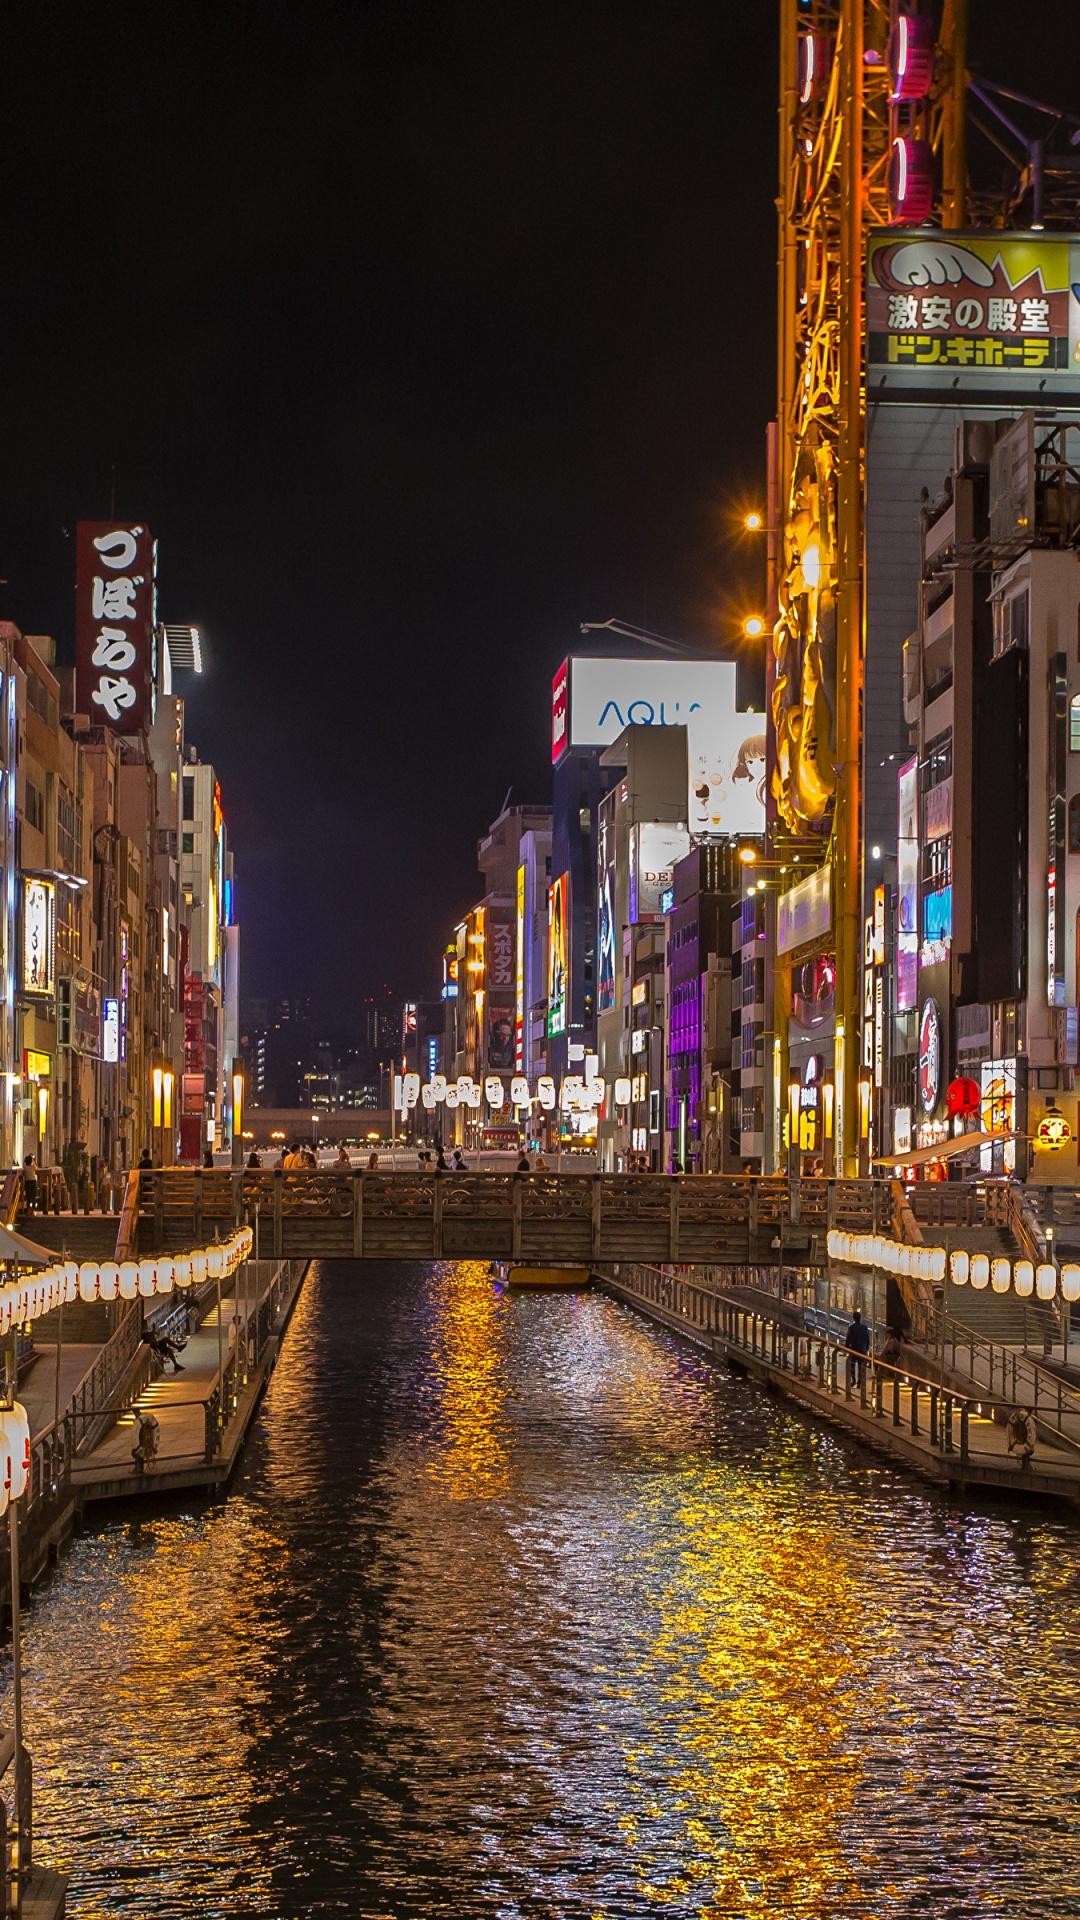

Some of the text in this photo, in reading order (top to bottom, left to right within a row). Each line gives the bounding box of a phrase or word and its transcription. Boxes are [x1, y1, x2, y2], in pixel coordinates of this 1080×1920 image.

[888, 294, 1050, 333] 激安の殿堂
[92, 526, 145, 720] づぼらや
[494, 924, 512, 985] スポタカ
